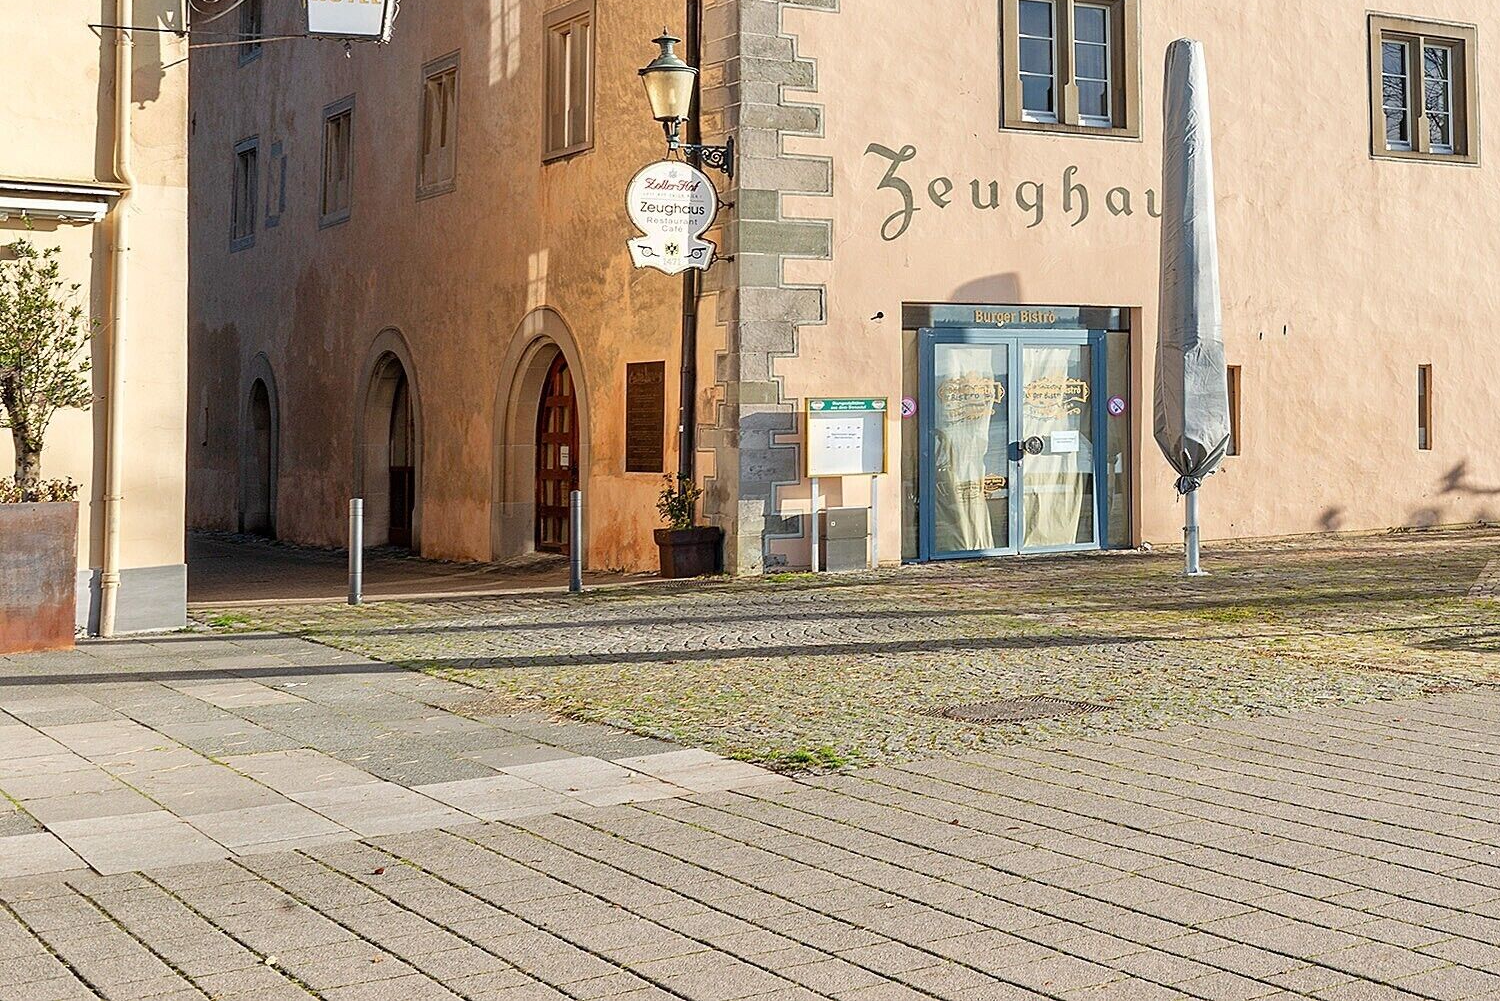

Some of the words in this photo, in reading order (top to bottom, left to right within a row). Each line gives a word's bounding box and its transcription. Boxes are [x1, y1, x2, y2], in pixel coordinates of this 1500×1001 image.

[864, 142, 1162, 241] Zeughau
[640, 201, 705, 216] Zeughaus
[647, 216, 698, 225] Restaurant
[974, 310, 1016, 327] Burger
